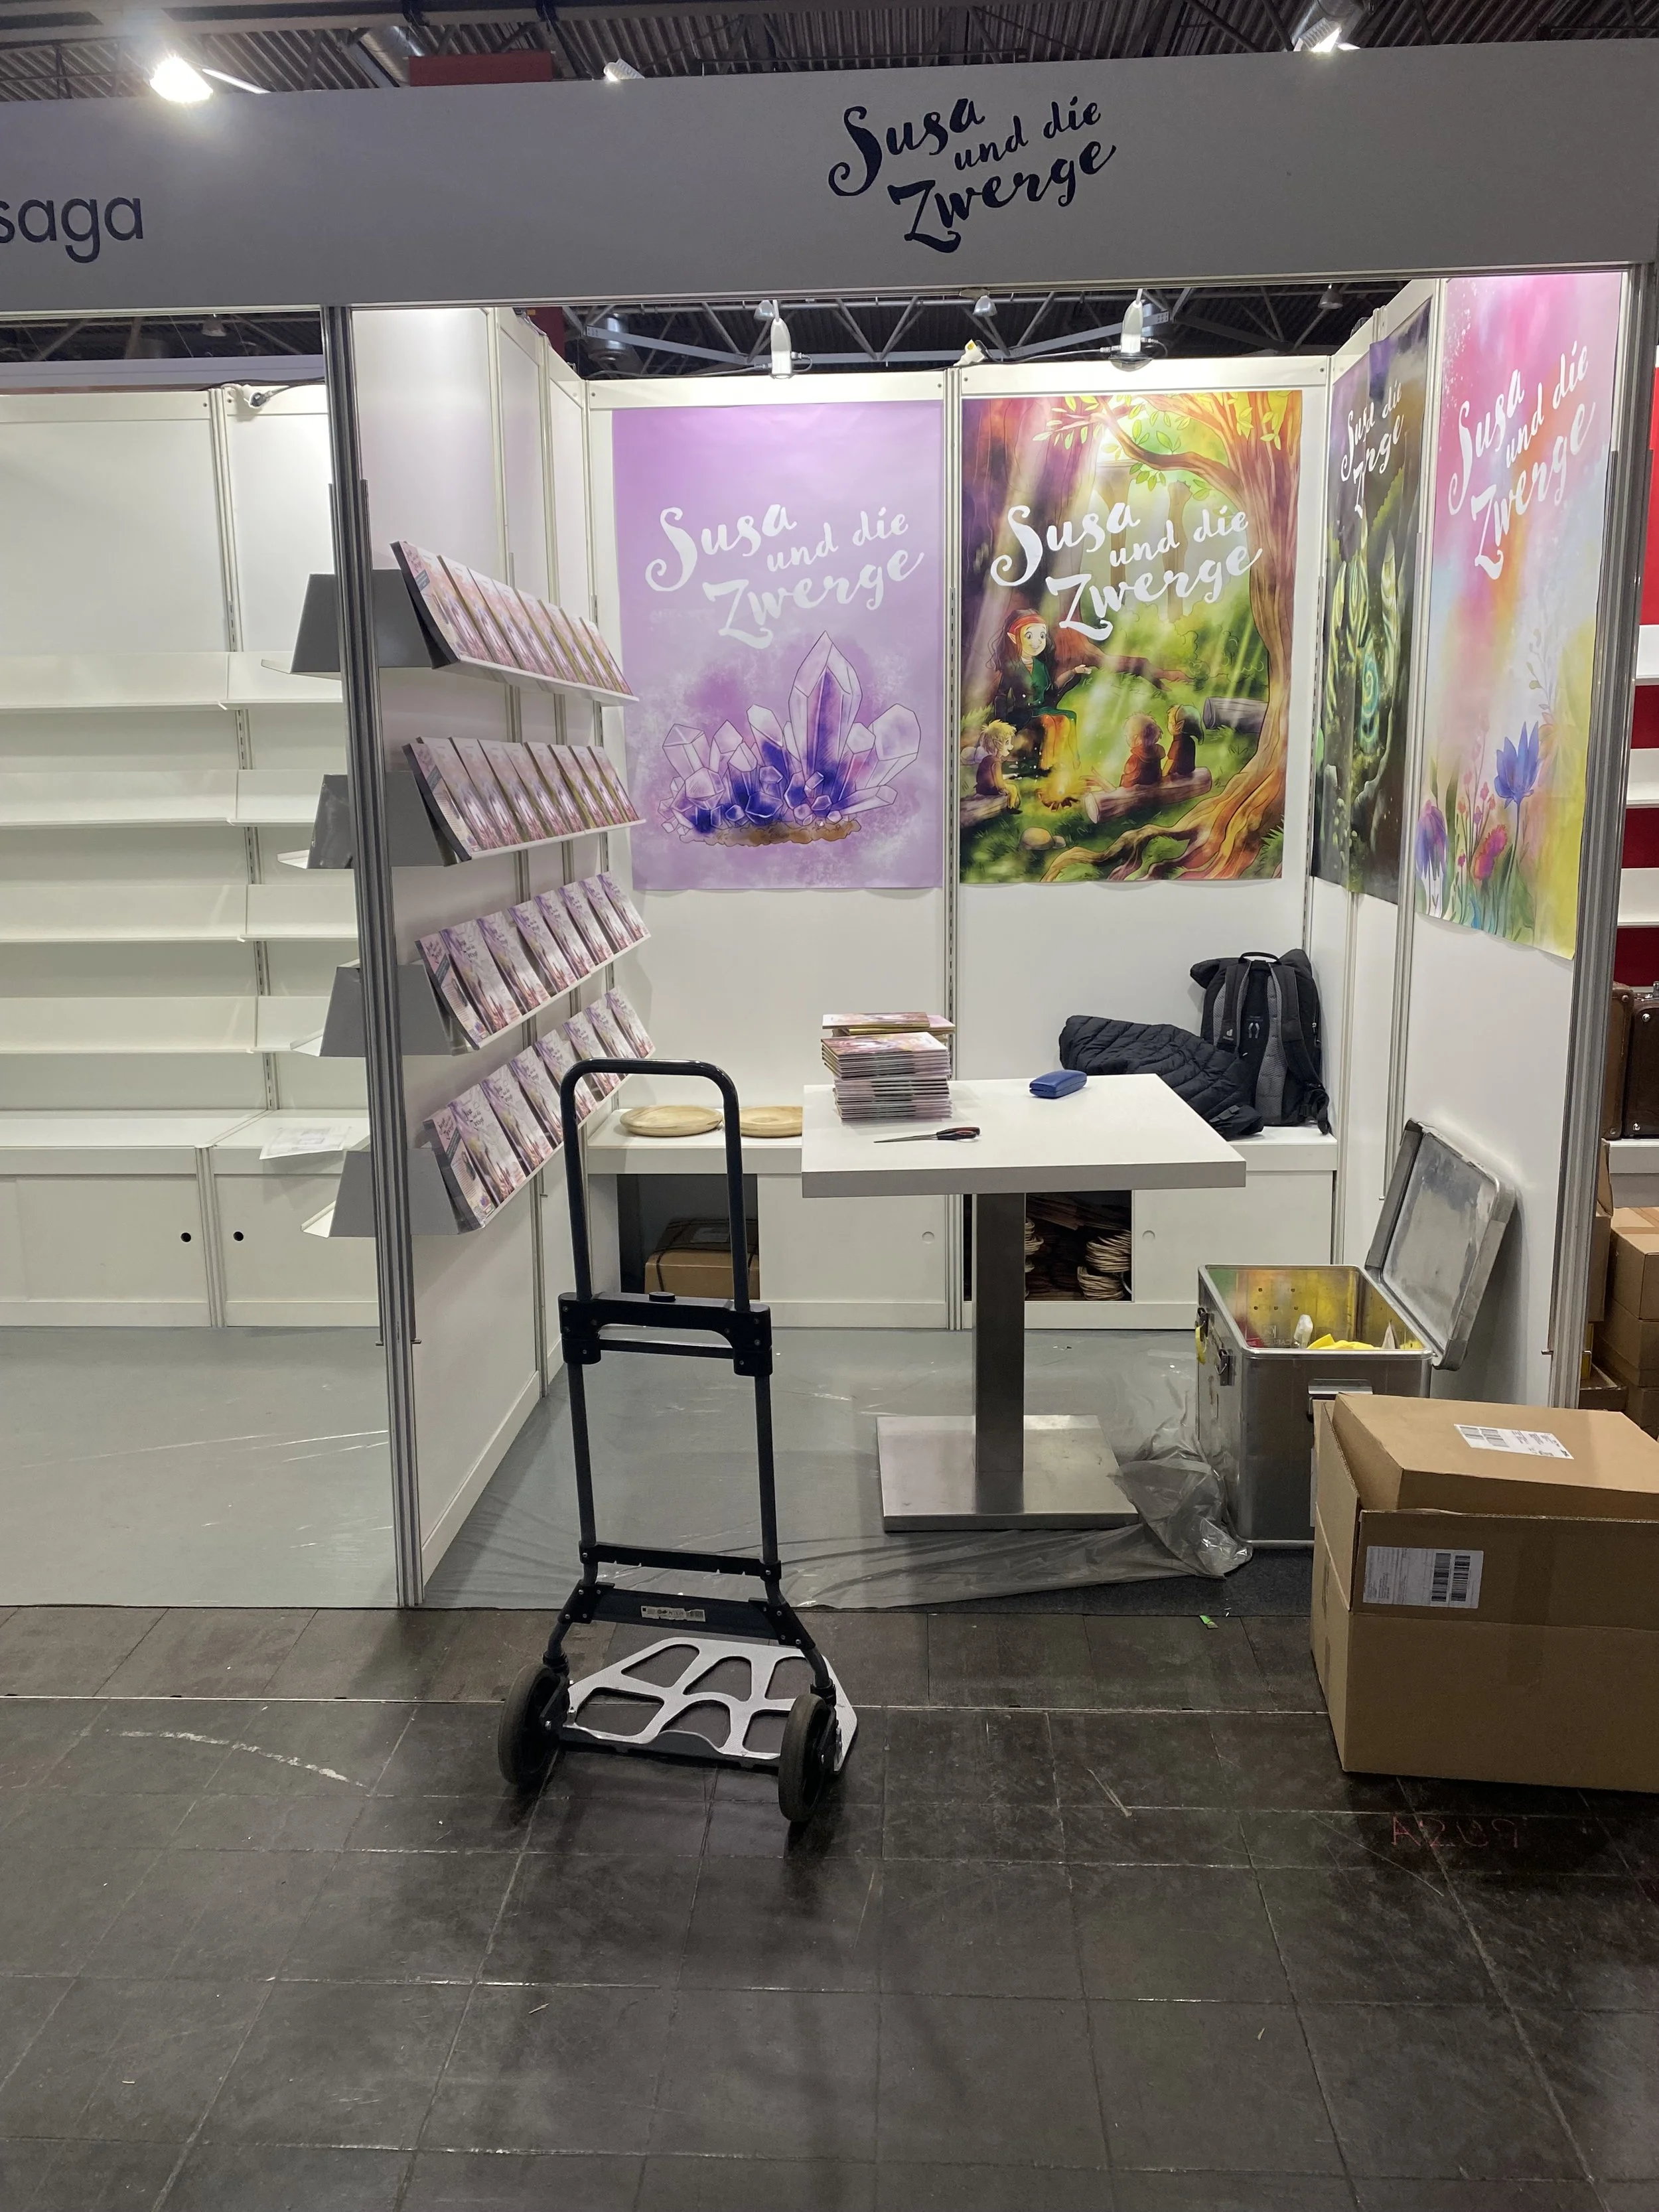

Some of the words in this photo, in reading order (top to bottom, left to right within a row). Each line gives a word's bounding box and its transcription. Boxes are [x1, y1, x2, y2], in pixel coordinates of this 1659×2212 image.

[828, 98, 985, 196] Susa
[954, 115, 1029, 171] und
[1043, 96, 1101, 139] die
[887, 141, 1117, 254] Zwerge
[1448, 369, 1525, 516] Susa
[1506, 382, 1544, 469] und
[1552, 340, 1588, 409] die
[1110, 520, 1180, 568] und
[1194, 504, 1248, 543] die
[1471, 402, 1596, 580] Zwerge
[644, 504, 797, 591] Susa
[766, 522, 839, 573] und
[852, 506, 908, 546] die
[990, 502, 1140, 587] Susa
[702, 549, 924, 649] Zwerge
[1046, 546, 1263, 641] Zwerge
